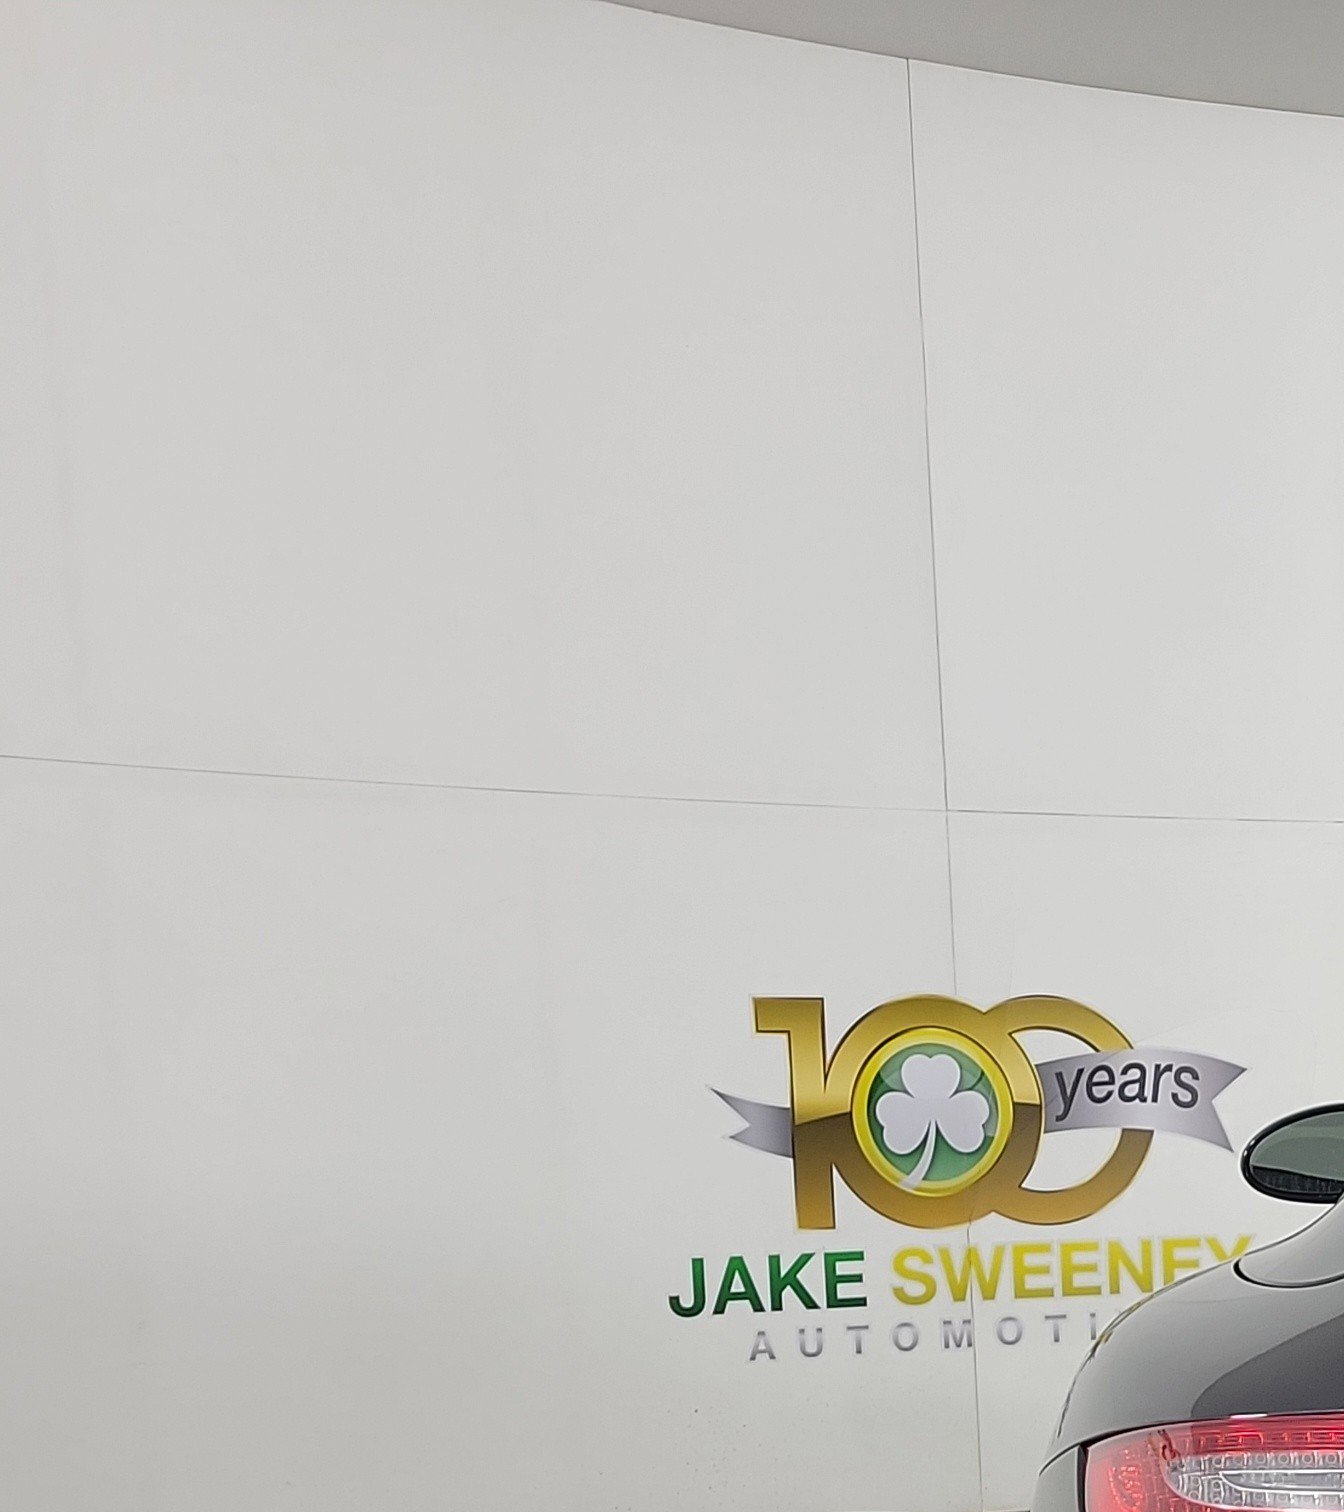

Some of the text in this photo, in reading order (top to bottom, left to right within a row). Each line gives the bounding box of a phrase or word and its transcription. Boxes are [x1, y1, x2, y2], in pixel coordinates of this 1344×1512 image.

[752, 994, 1200, 1230] 100 years
[668, 1250, 868, 1318] JAKE
[748, 1312, 1098, 1362] AUTOMOTI
